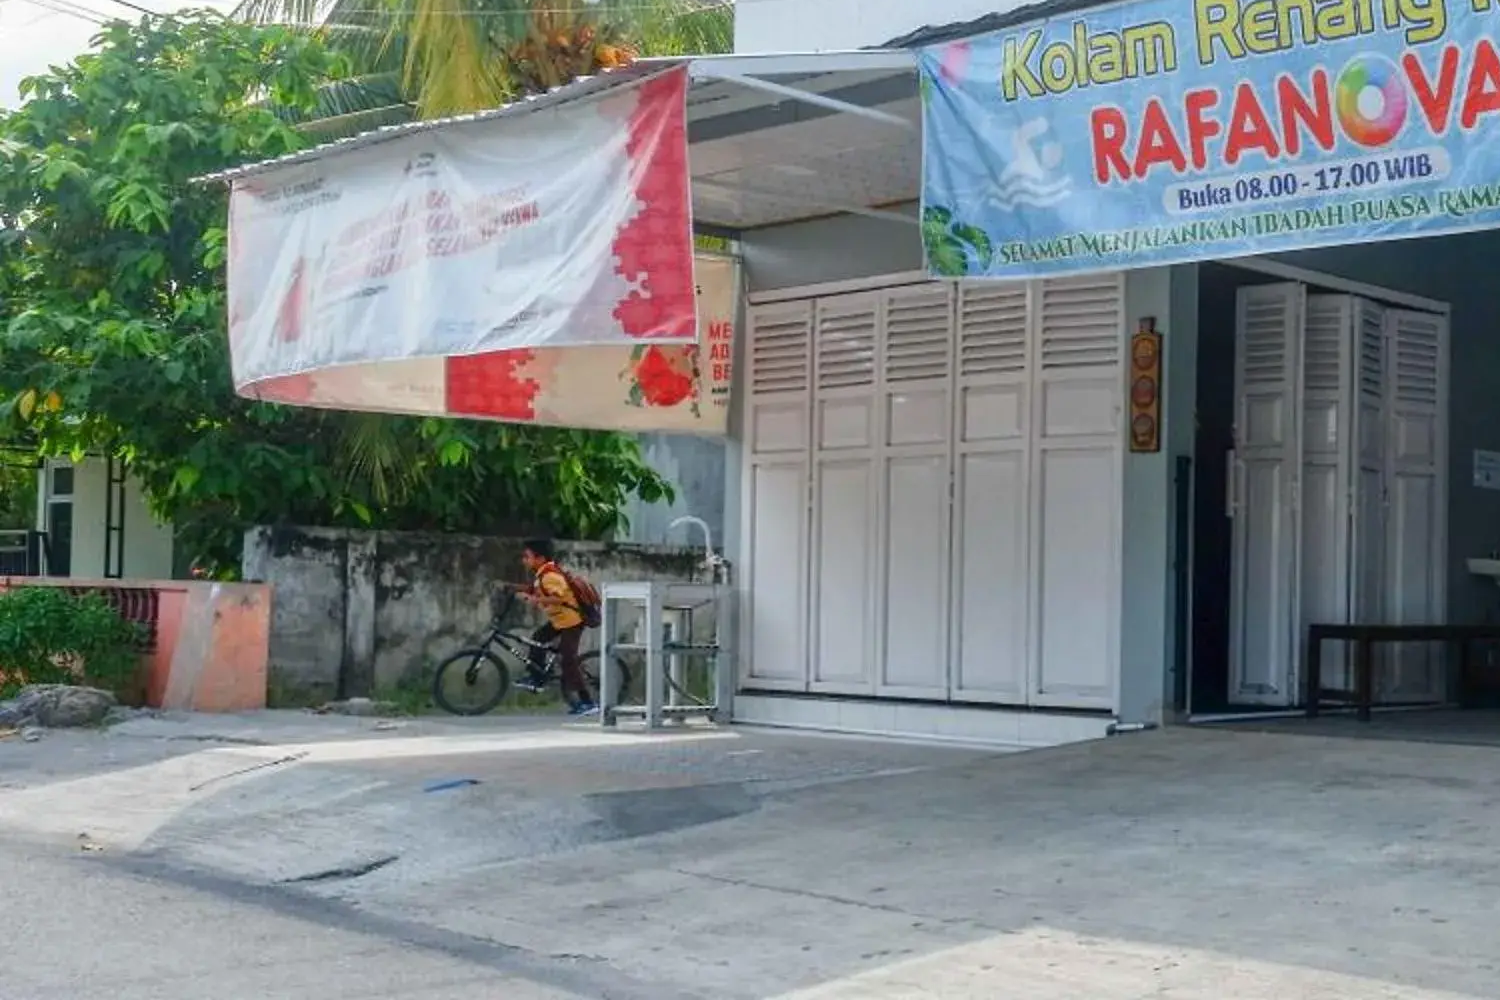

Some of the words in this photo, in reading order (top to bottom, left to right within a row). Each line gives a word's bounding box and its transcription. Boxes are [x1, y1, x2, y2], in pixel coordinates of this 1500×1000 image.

[1001, 21, 1177, 101] Kolam
[1178, 184, 1231, 210] Buka
[1235, 172, 1298, 202] 08.00
[1314, 161, 1380, 192] 17.00
[1385, 152, 1433, 182] WIB
[1000, 236, 1077, 264] SELAMAT
[1078, 217, 1247, 256] MENJALANKAN
[1250, 206, 1344, 235] IBADAH
[1350, 196, 1431, 223] PUASA
